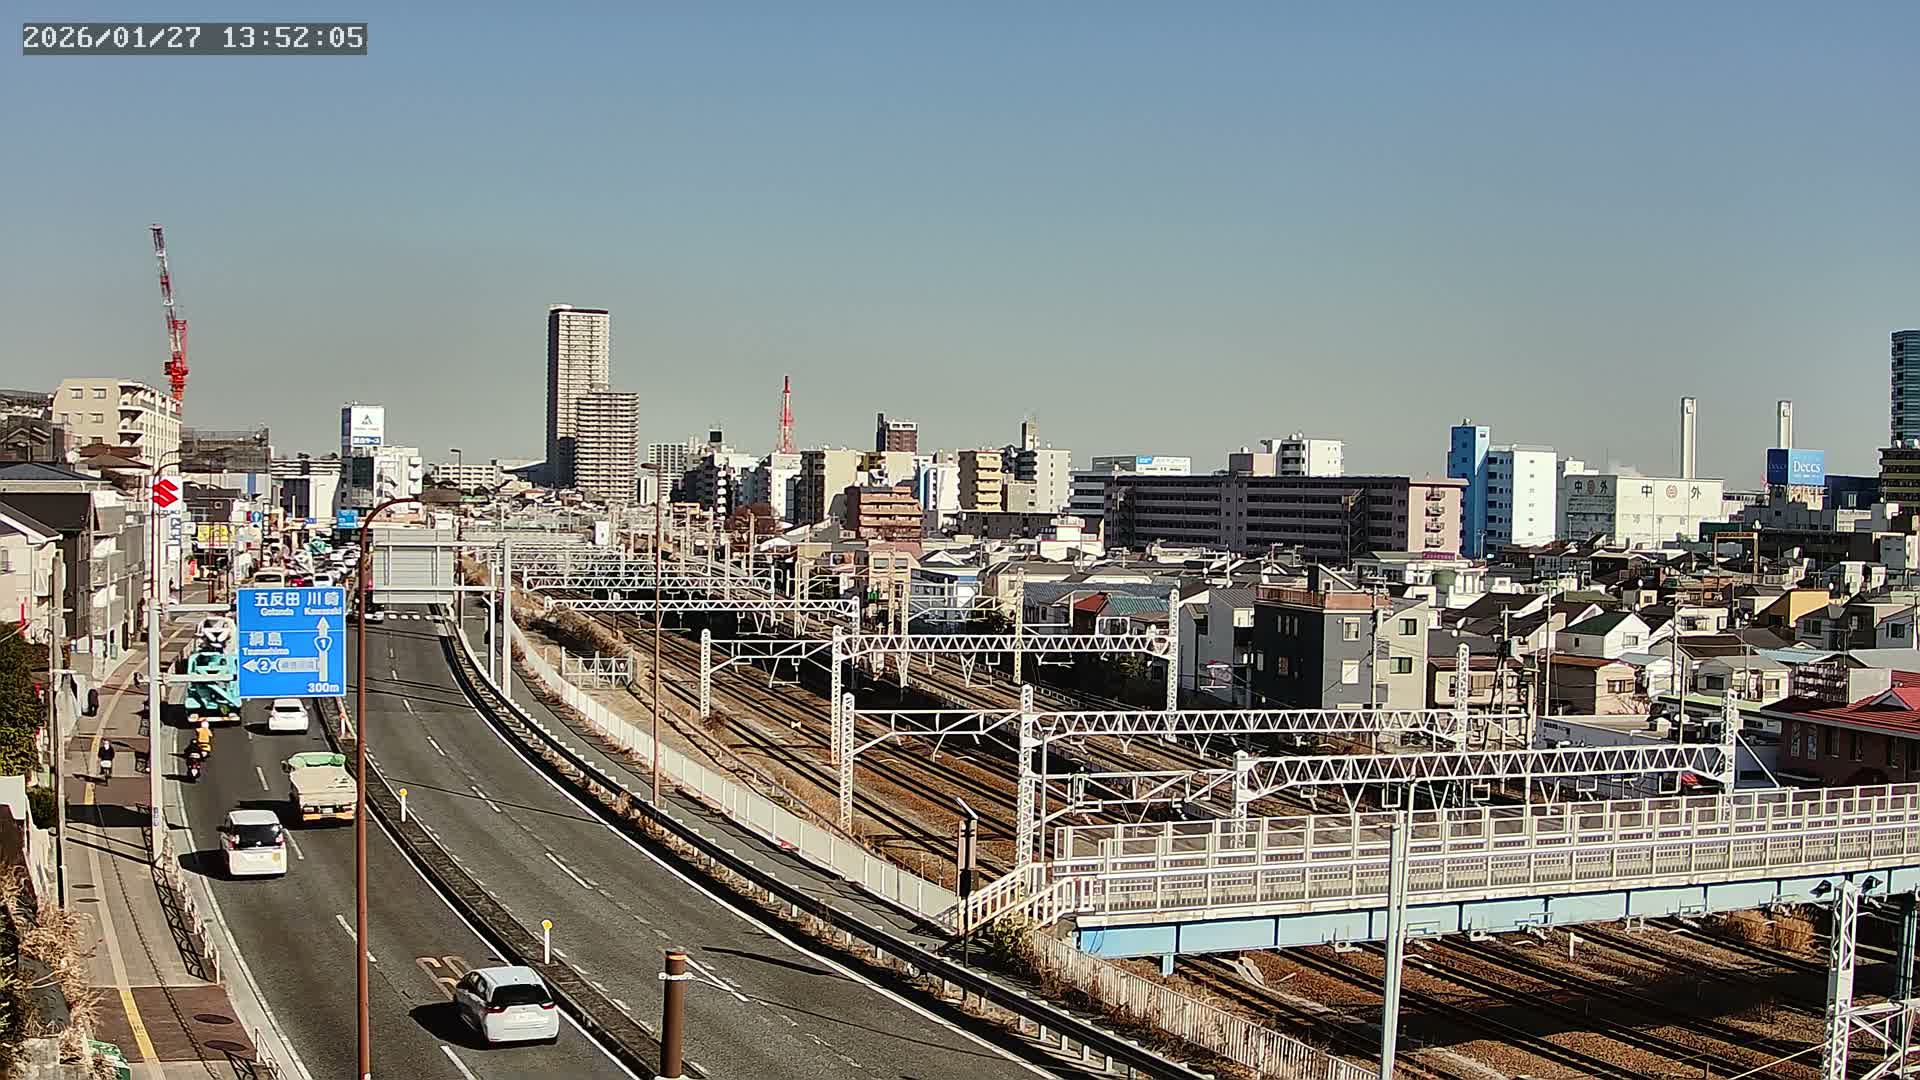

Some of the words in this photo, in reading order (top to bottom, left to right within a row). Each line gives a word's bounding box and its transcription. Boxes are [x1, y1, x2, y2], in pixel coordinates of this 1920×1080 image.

[1641, 484, 1653, 498] 中
[254, 592, 300, 607] 五反田
[260, 661, 268, 670] 2
[307, 683, 340, 693] 300m
